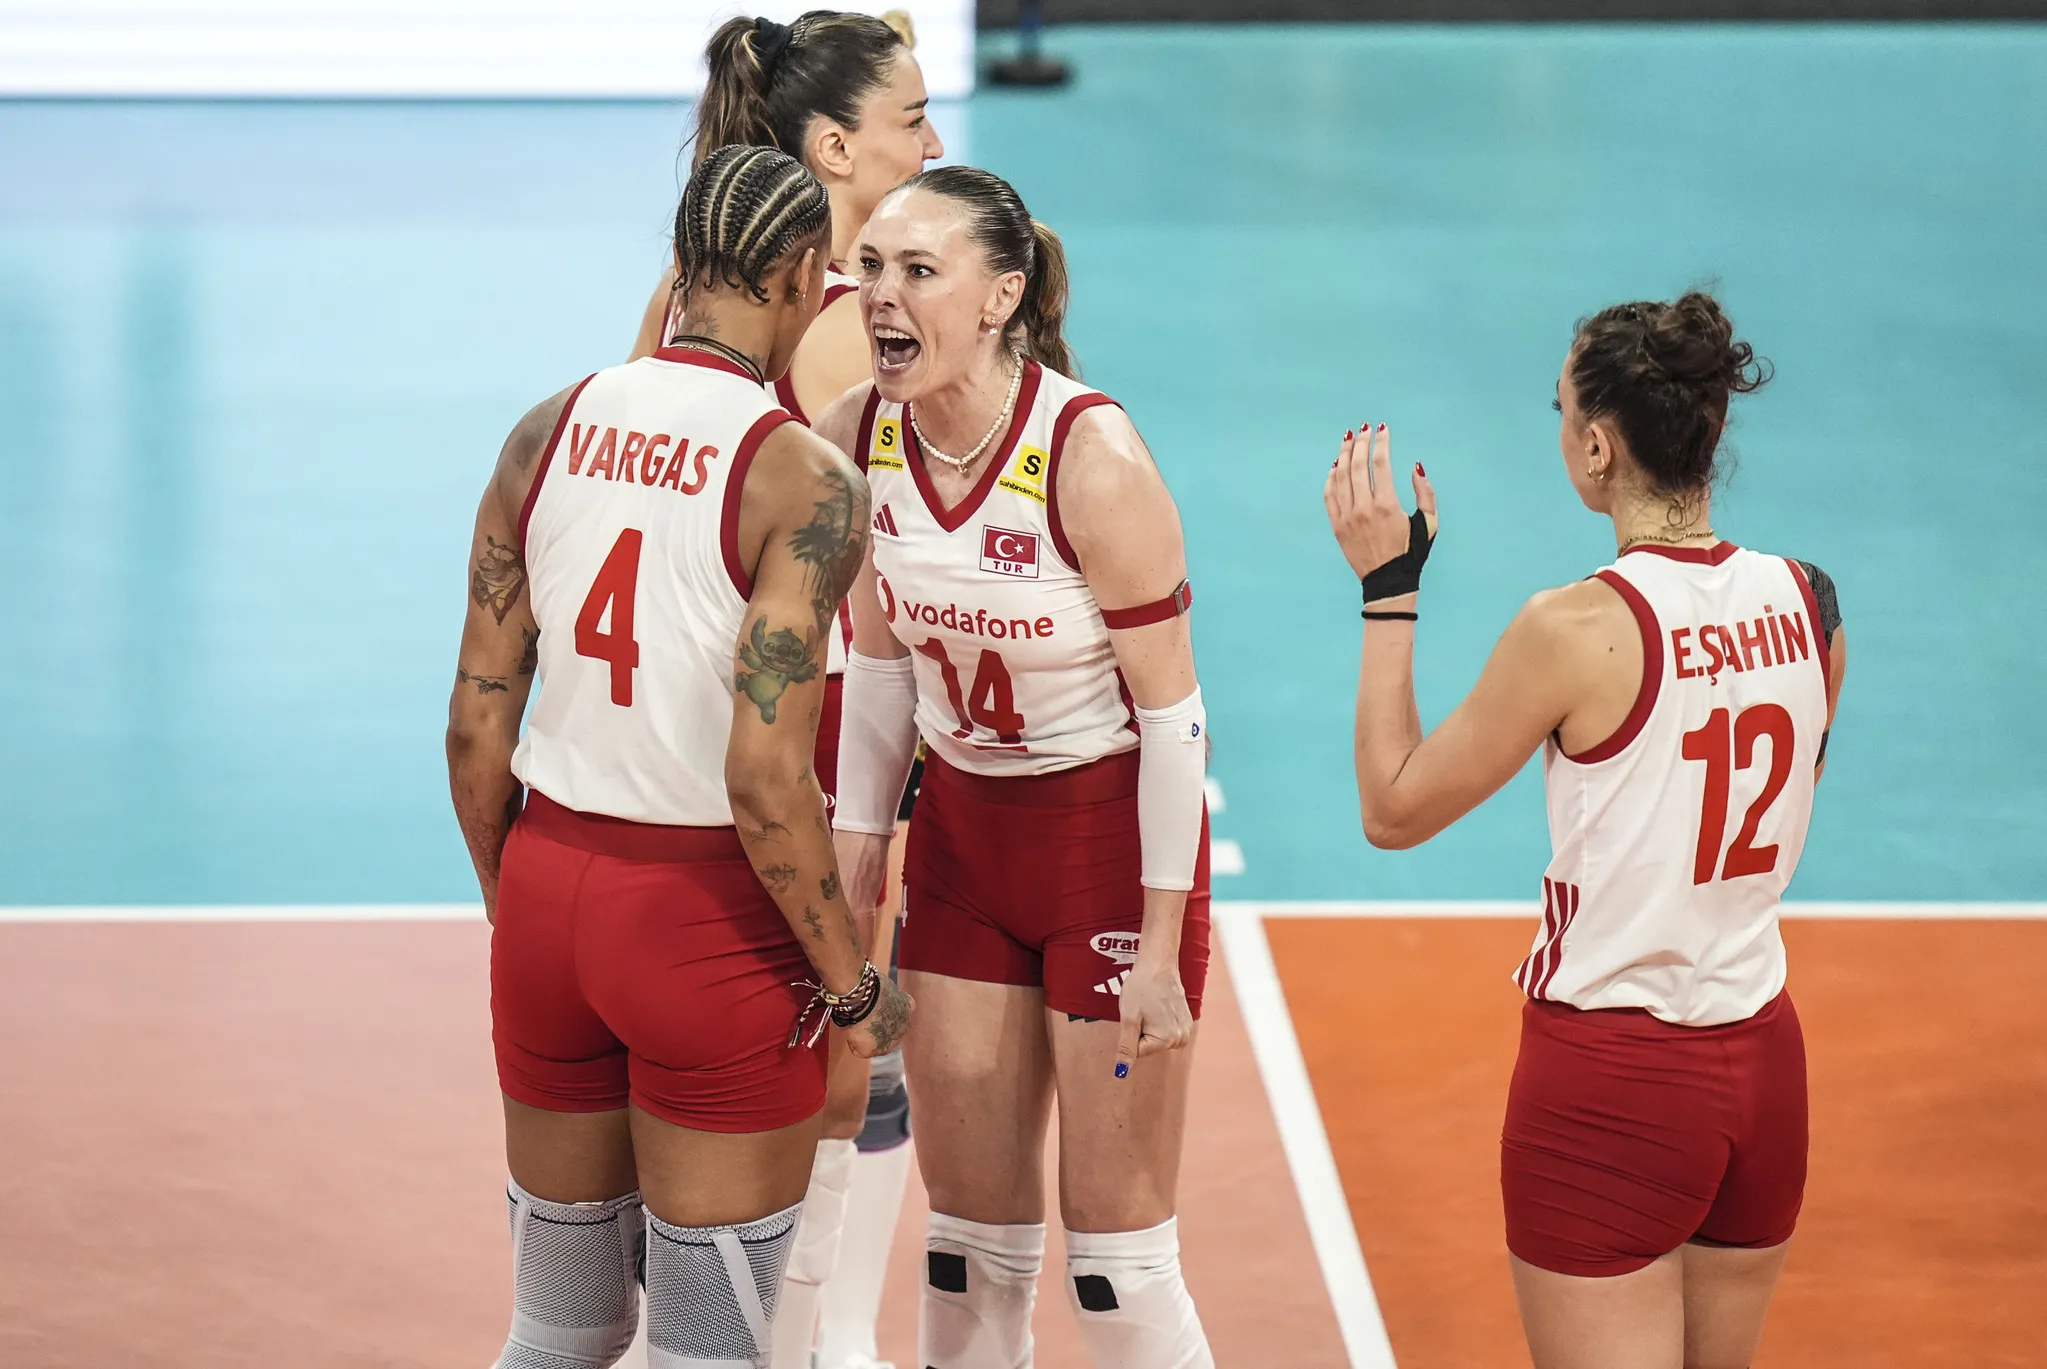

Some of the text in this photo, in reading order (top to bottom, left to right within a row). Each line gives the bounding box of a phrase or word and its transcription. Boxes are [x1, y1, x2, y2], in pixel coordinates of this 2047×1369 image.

[881, 425, 894, 447] S
[568, 423, 719, 496] VARGAS
[1023, 454, 1042, 476] S
[999, 479, 1046, 503] sahibinden.com
[993, 560, 1023, 573] TUR
[574, 527, 643, 707] 4
[902, 602, 1054, 640] vodafone
[1671, 604, 1810, 685] E.ŞAHİN
[914, 636, 1025, 745] 14
[1681, 703, 1795, 885] 12
[1098, 936, 1140, 951] grat
